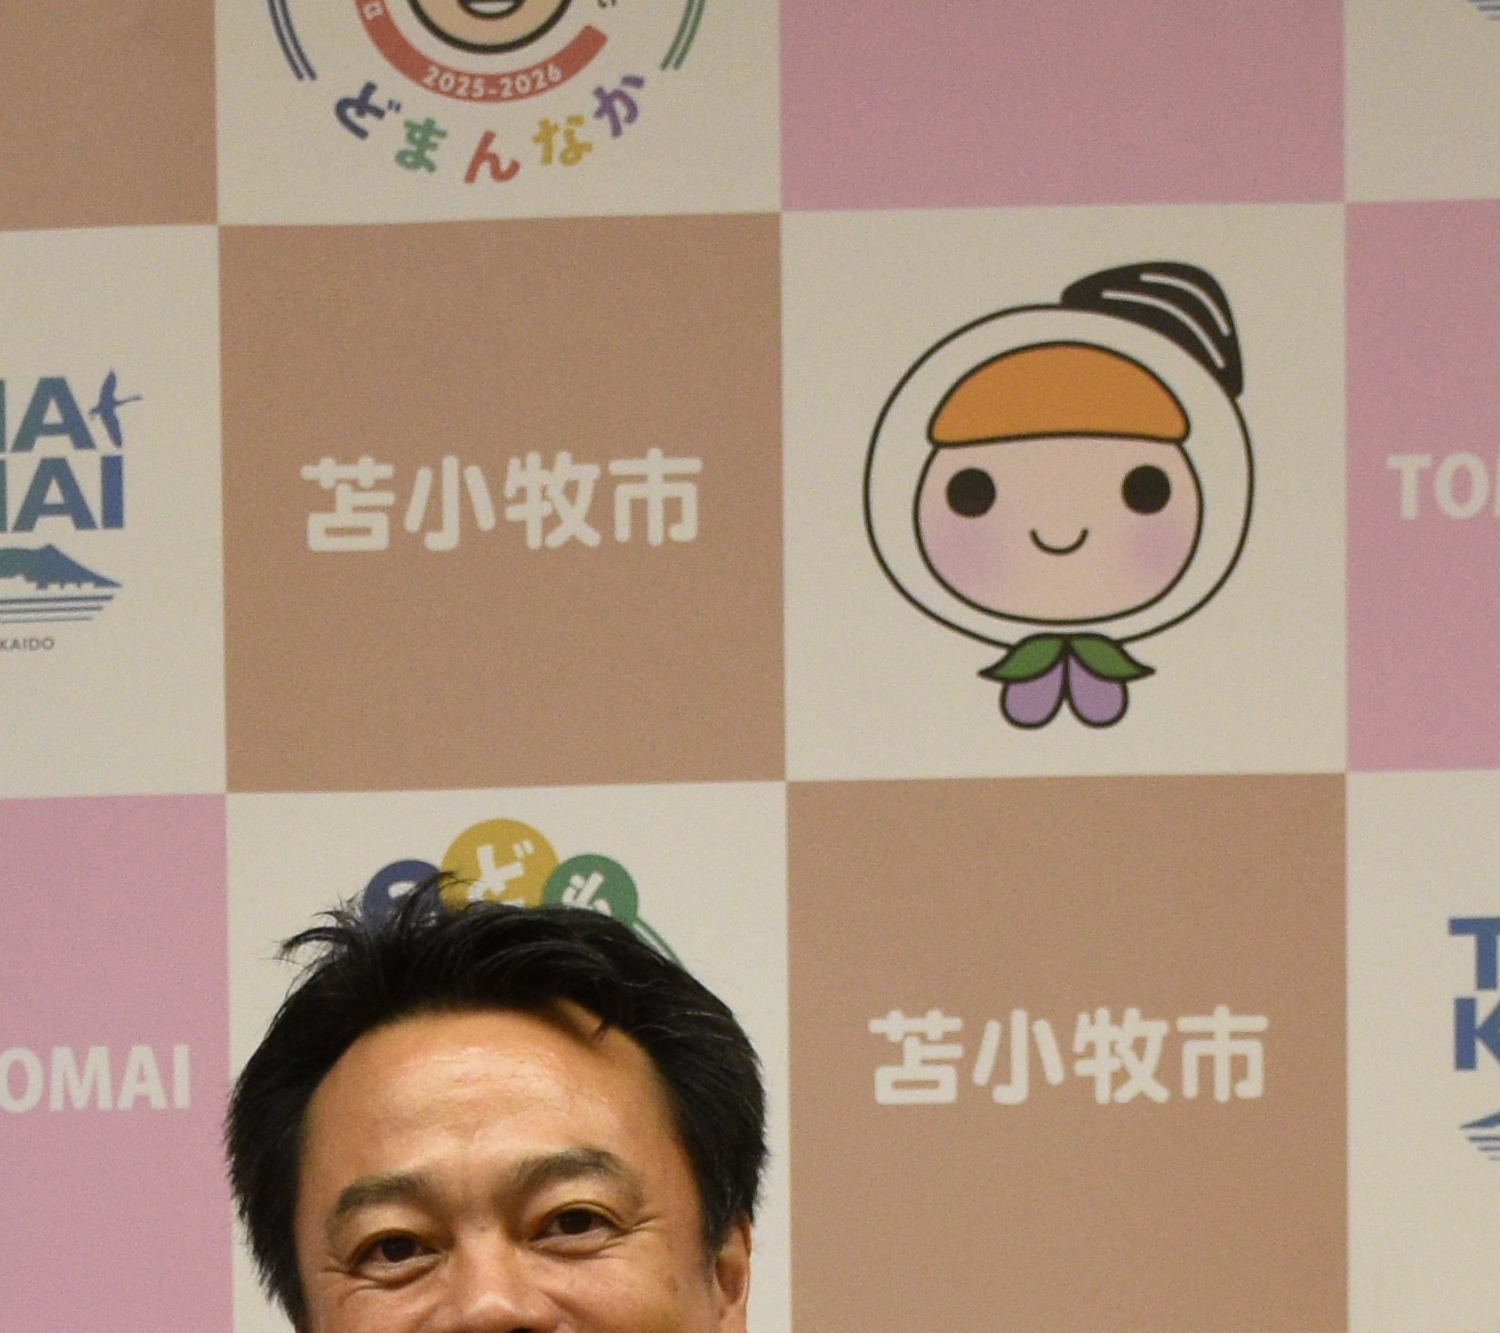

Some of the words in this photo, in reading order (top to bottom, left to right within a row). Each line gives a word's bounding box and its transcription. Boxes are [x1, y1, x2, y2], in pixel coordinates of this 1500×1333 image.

[334, 76, 645, 184] どまんなか
[421, 62, 564, 100] 2025-2026
[301, 447, 703, 552] 苫小牧市
[869, 1005, 1268, 1105] 苫小牧市
